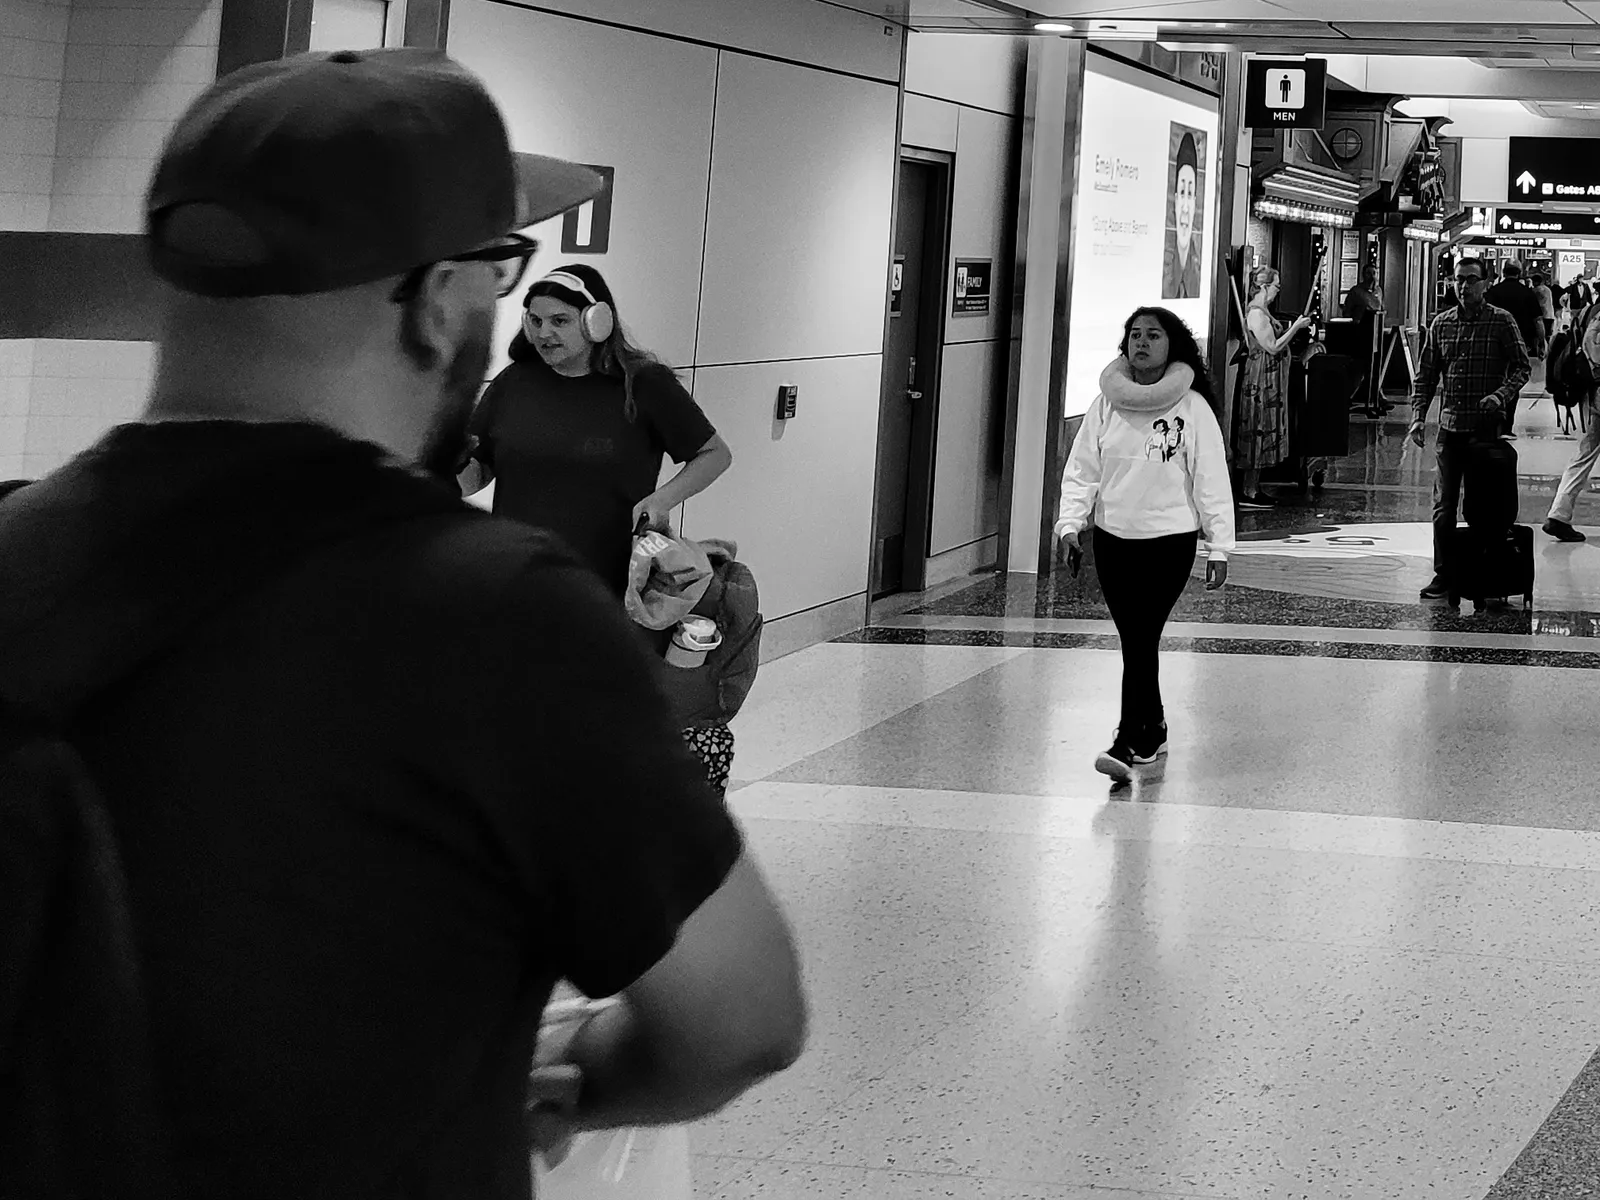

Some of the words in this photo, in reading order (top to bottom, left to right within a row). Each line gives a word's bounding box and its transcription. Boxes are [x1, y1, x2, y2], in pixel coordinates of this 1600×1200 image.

[1273, 111, 1296, 122] MEN
[1556, 185, 1585, 195] Gates
[1562, 253, 1582, 263] A25
